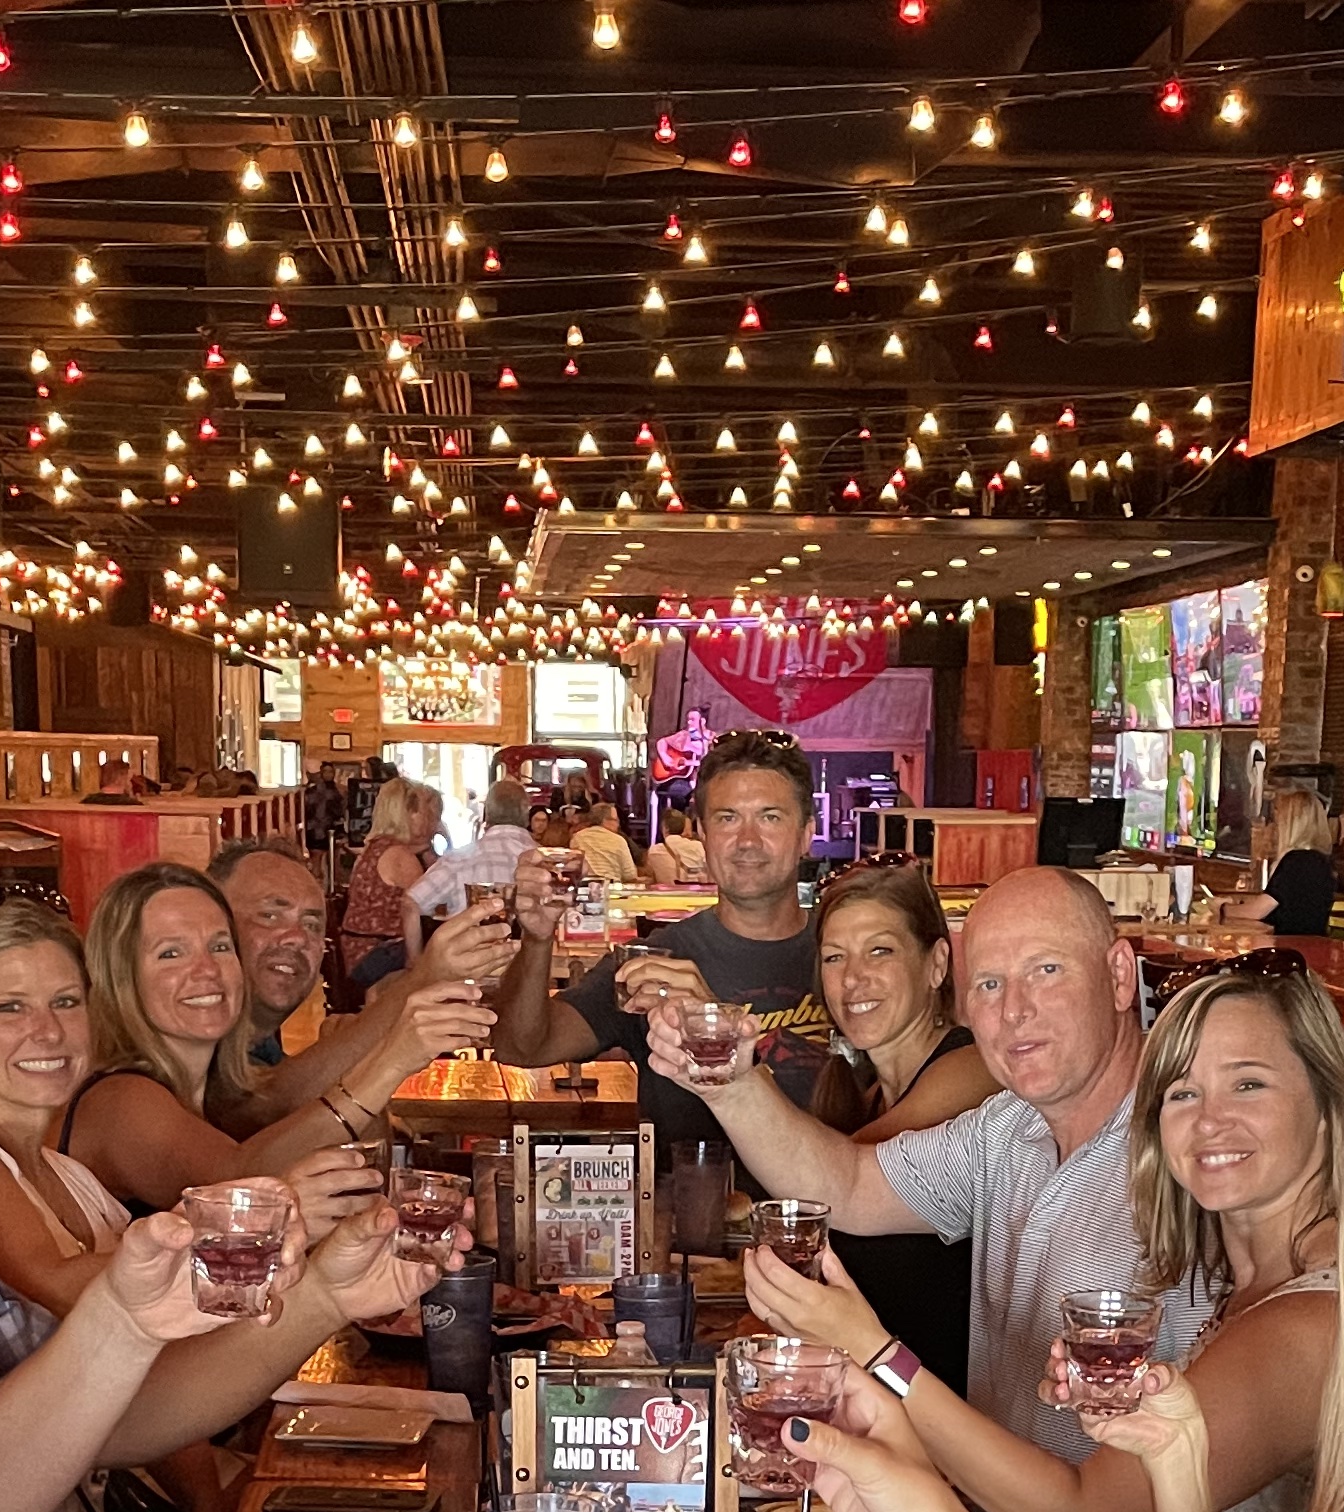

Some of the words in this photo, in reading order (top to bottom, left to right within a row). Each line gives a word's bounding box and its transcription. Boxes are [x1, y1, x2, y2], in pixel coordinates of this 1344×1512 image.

[720, 624, 871, 685] JONES
[573, 1161, 630, 1179] BRUNCH
[654, 1404, 685, 1419] GEORGE
[551, 1416, 645, 1446] THIRST
[651, 1417, 683, 1437] JONES
[553, 1447, 595, 1471] AND
[598, 1448, 640, 1471] TEN.
